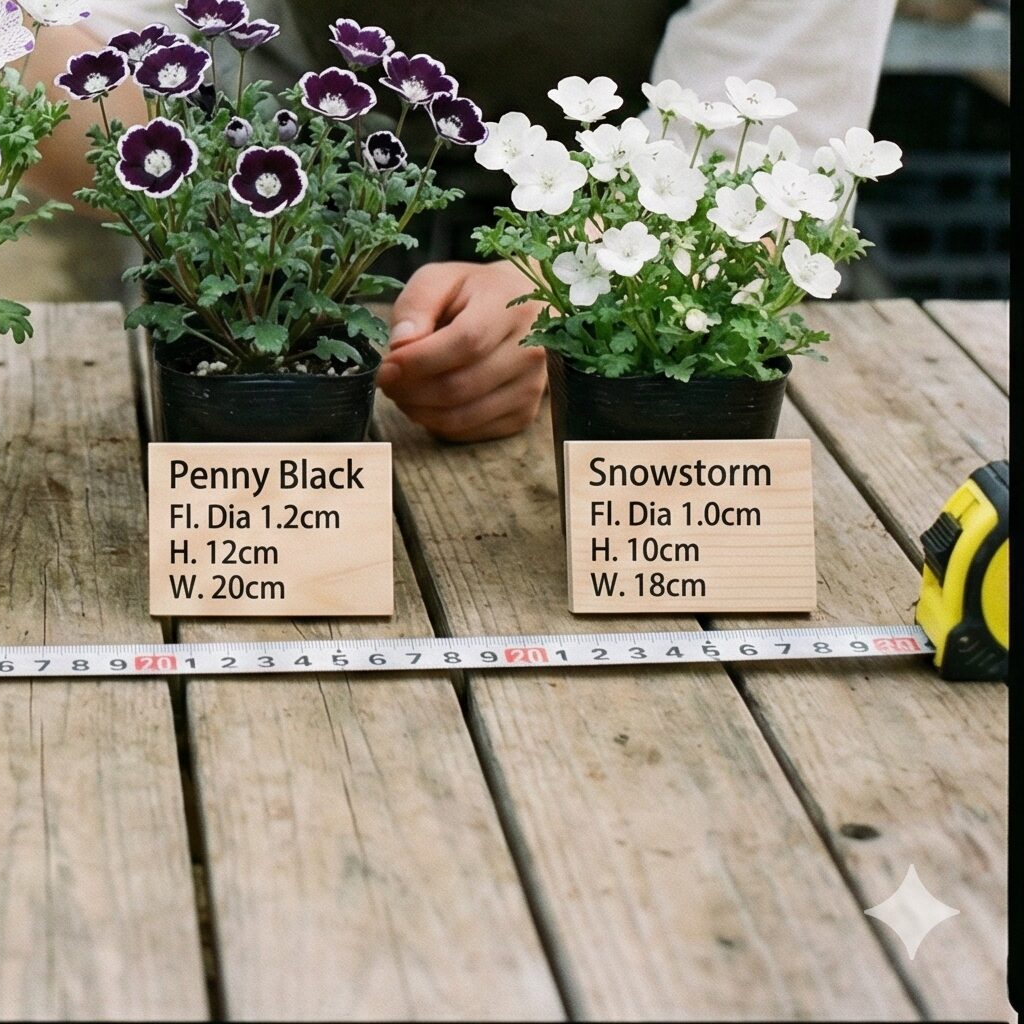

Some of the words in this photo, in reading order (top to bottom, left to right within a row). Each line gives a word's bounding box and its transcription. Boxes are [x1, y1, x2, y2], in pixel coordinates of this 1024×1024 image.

[170, 459, 270, 498] Penny
[280, 458, 365, 490] Black
[589, 457, 772, 487] Snowstorm
[170, 503, 199, 529] Fl.
[208, 503, 251, 529] Dia
[261, 504, 340, 529] 1.2cm
[591, 500, 621, 526] Fl.
[629, 501, 672, 527] Dia
[682, 501, 761, 527] 1.0cm
[170, 539, 197, 565] H.
[206, 539, 278, 565] 12cm
[591, 537, 618, 562] H.
[627, 537, 699, 562] 10cm
[169, 574, 204, 600] W.
[211, 574, 285, 600] 20cm
[591, 572, 625, 597] W.
[634, 572, 706, 597] 18cm
[33, 659, 51, 672] 7
[71, 659, 90, 671] 8
[109, 658, 128, 670] 9
[139, 656, 172, 670] 20
[184, 657, 196, 669] 1
[220, 657, 238, 669] 2
[257, 656, 275, 668] 3
[293, 655, 313, 667] 4
[331, 654, 350, 666] 5
[368, 653, 387, 666] 6
[404, 652, 423, 665] 7
[443, 651, 462, 664] 8
[480, 651, 499, 663] 9
[510, 648, 543, 662] 20
[554, 649, 568, 662] 1
[590, 648, 609, 661] 2
[628, 647, 648, 659] 3
[664, 645, 684, 658] 4
[702, 645, 720, 657] 5
[739, 644, 758, 656] 6
[773, 643, 791, 655] 7
[813, 641, 832, 654] 8
[849, 640, 869, 653] 9
